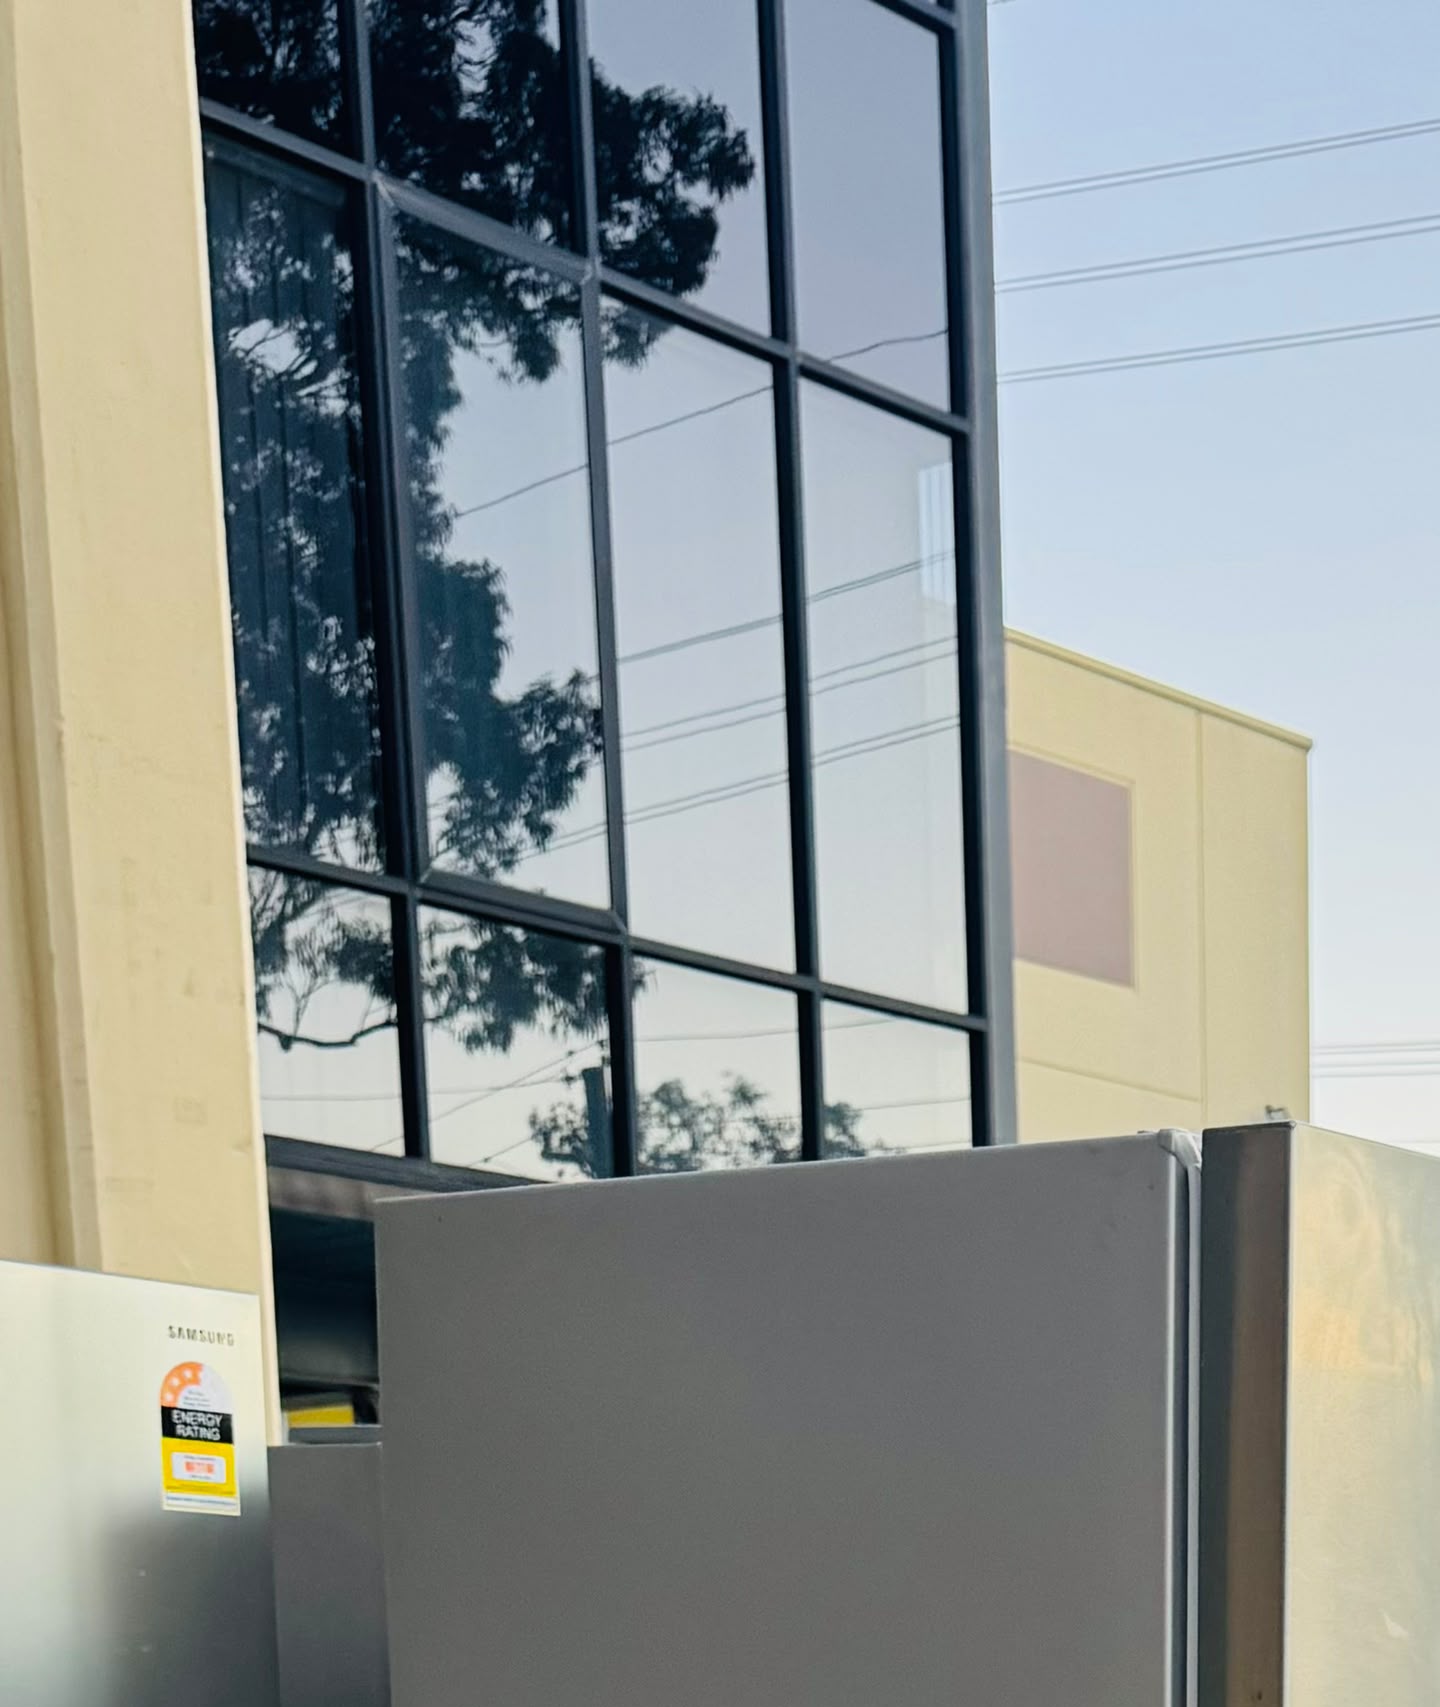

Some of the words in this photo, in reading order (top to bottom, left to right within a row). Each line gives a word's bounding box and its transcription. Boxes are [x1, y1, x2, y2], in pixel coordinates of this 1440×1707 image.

[168, 1325, 234, 1346] SAMSUNG
[172, 1409, 222, 1427] ENERGY
[175, 1424, 220, 1441] RATING
